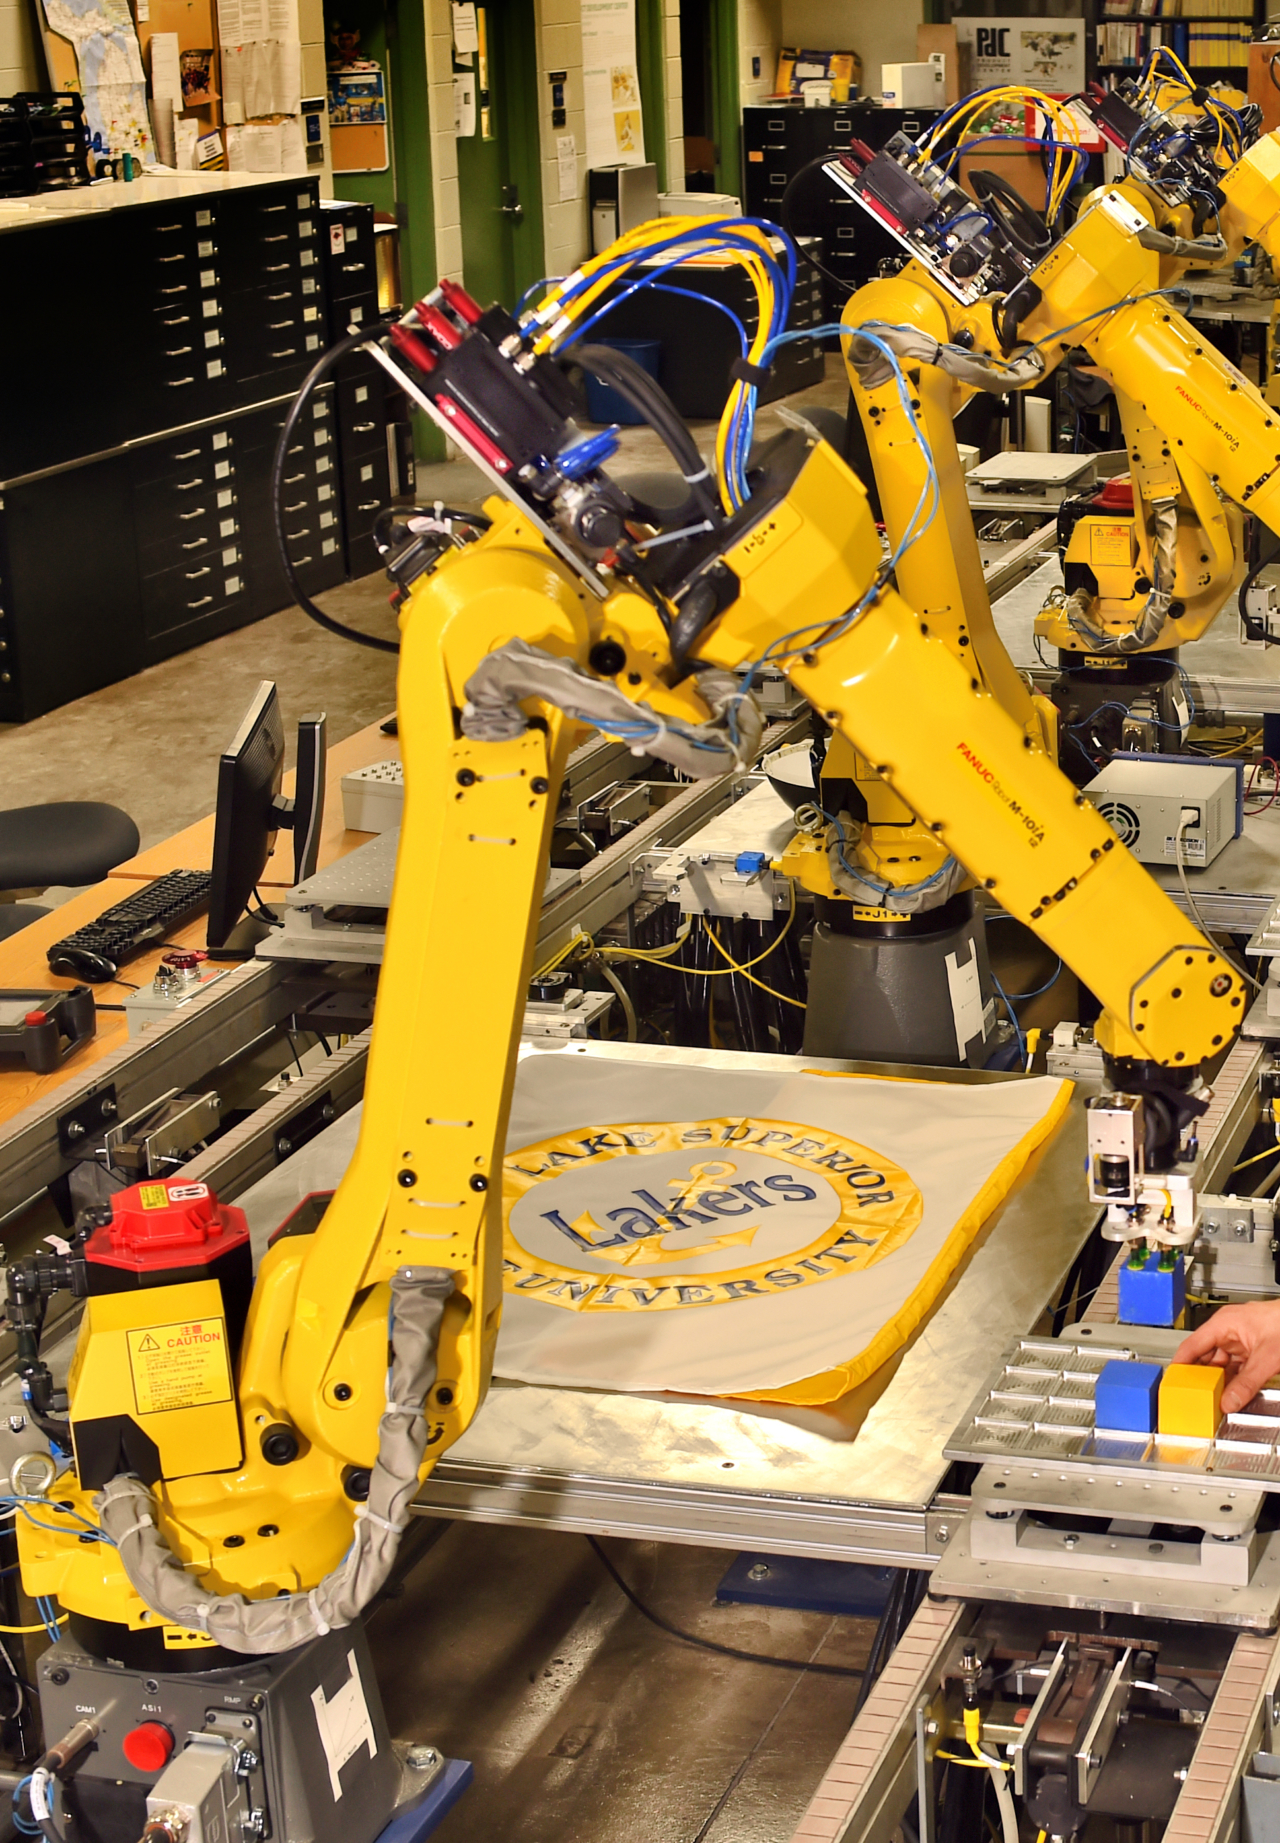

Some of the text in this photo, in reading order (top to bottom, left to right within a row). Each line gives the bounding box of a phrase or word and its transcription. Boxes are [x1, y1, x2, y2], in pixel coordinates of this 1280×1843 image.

[1174, 385, 1203, 412] FANUC
[1213, 421, 1241, 450] M-10iA
[956, 742, 995, 784] FANUC
[1008, 800, 1046, 843] M-10iA
[510, 1123, 895, 1208] LAKE SUPERIOR
[539, 1174, 818, 1253] Lakers
[514, 1229, 880, 1306] UNIVERSITY
[166, 1332, 221, 1348] CAUTION
[180, 1324, 202, 1337] 注意
[75, 1704, 97, 1714] CAM1
[141, 1703, 163, 1713] ASi1
